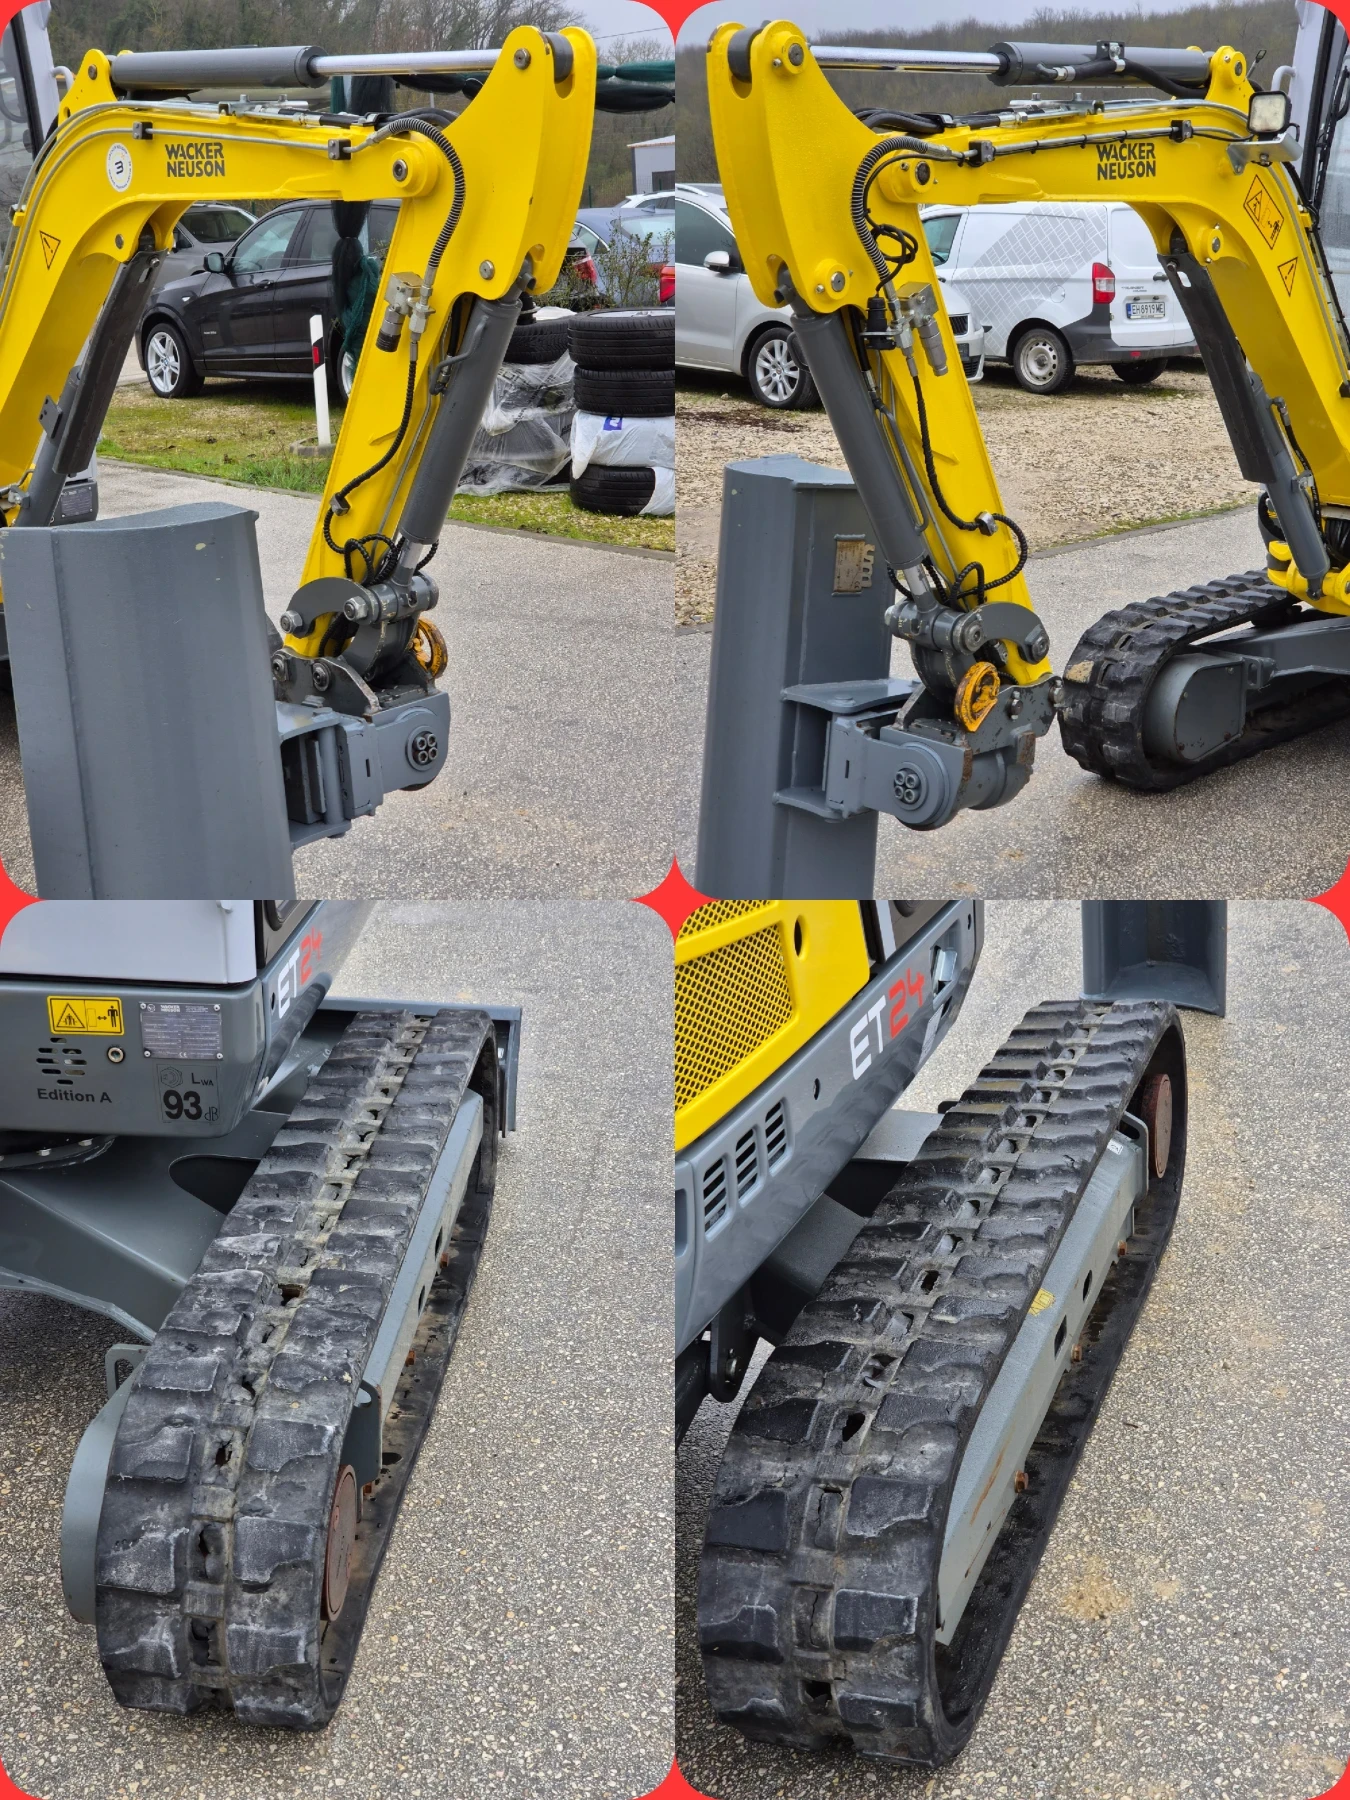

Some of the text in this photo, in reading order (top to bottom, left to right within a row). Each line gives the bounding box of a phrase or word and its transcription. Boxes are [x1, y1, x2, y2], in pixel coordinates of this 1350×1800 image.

[164, 142, 225, 160] WACKER
[1096, 142, 1156, 162] WACKER
[166, 159, 226, 178] NEUSON
[1097, 160, 1156, 181] NEUSON
[36, 1087, 113, 1104] Edition A
[163, 1089, 220, 1122] 93 dB
